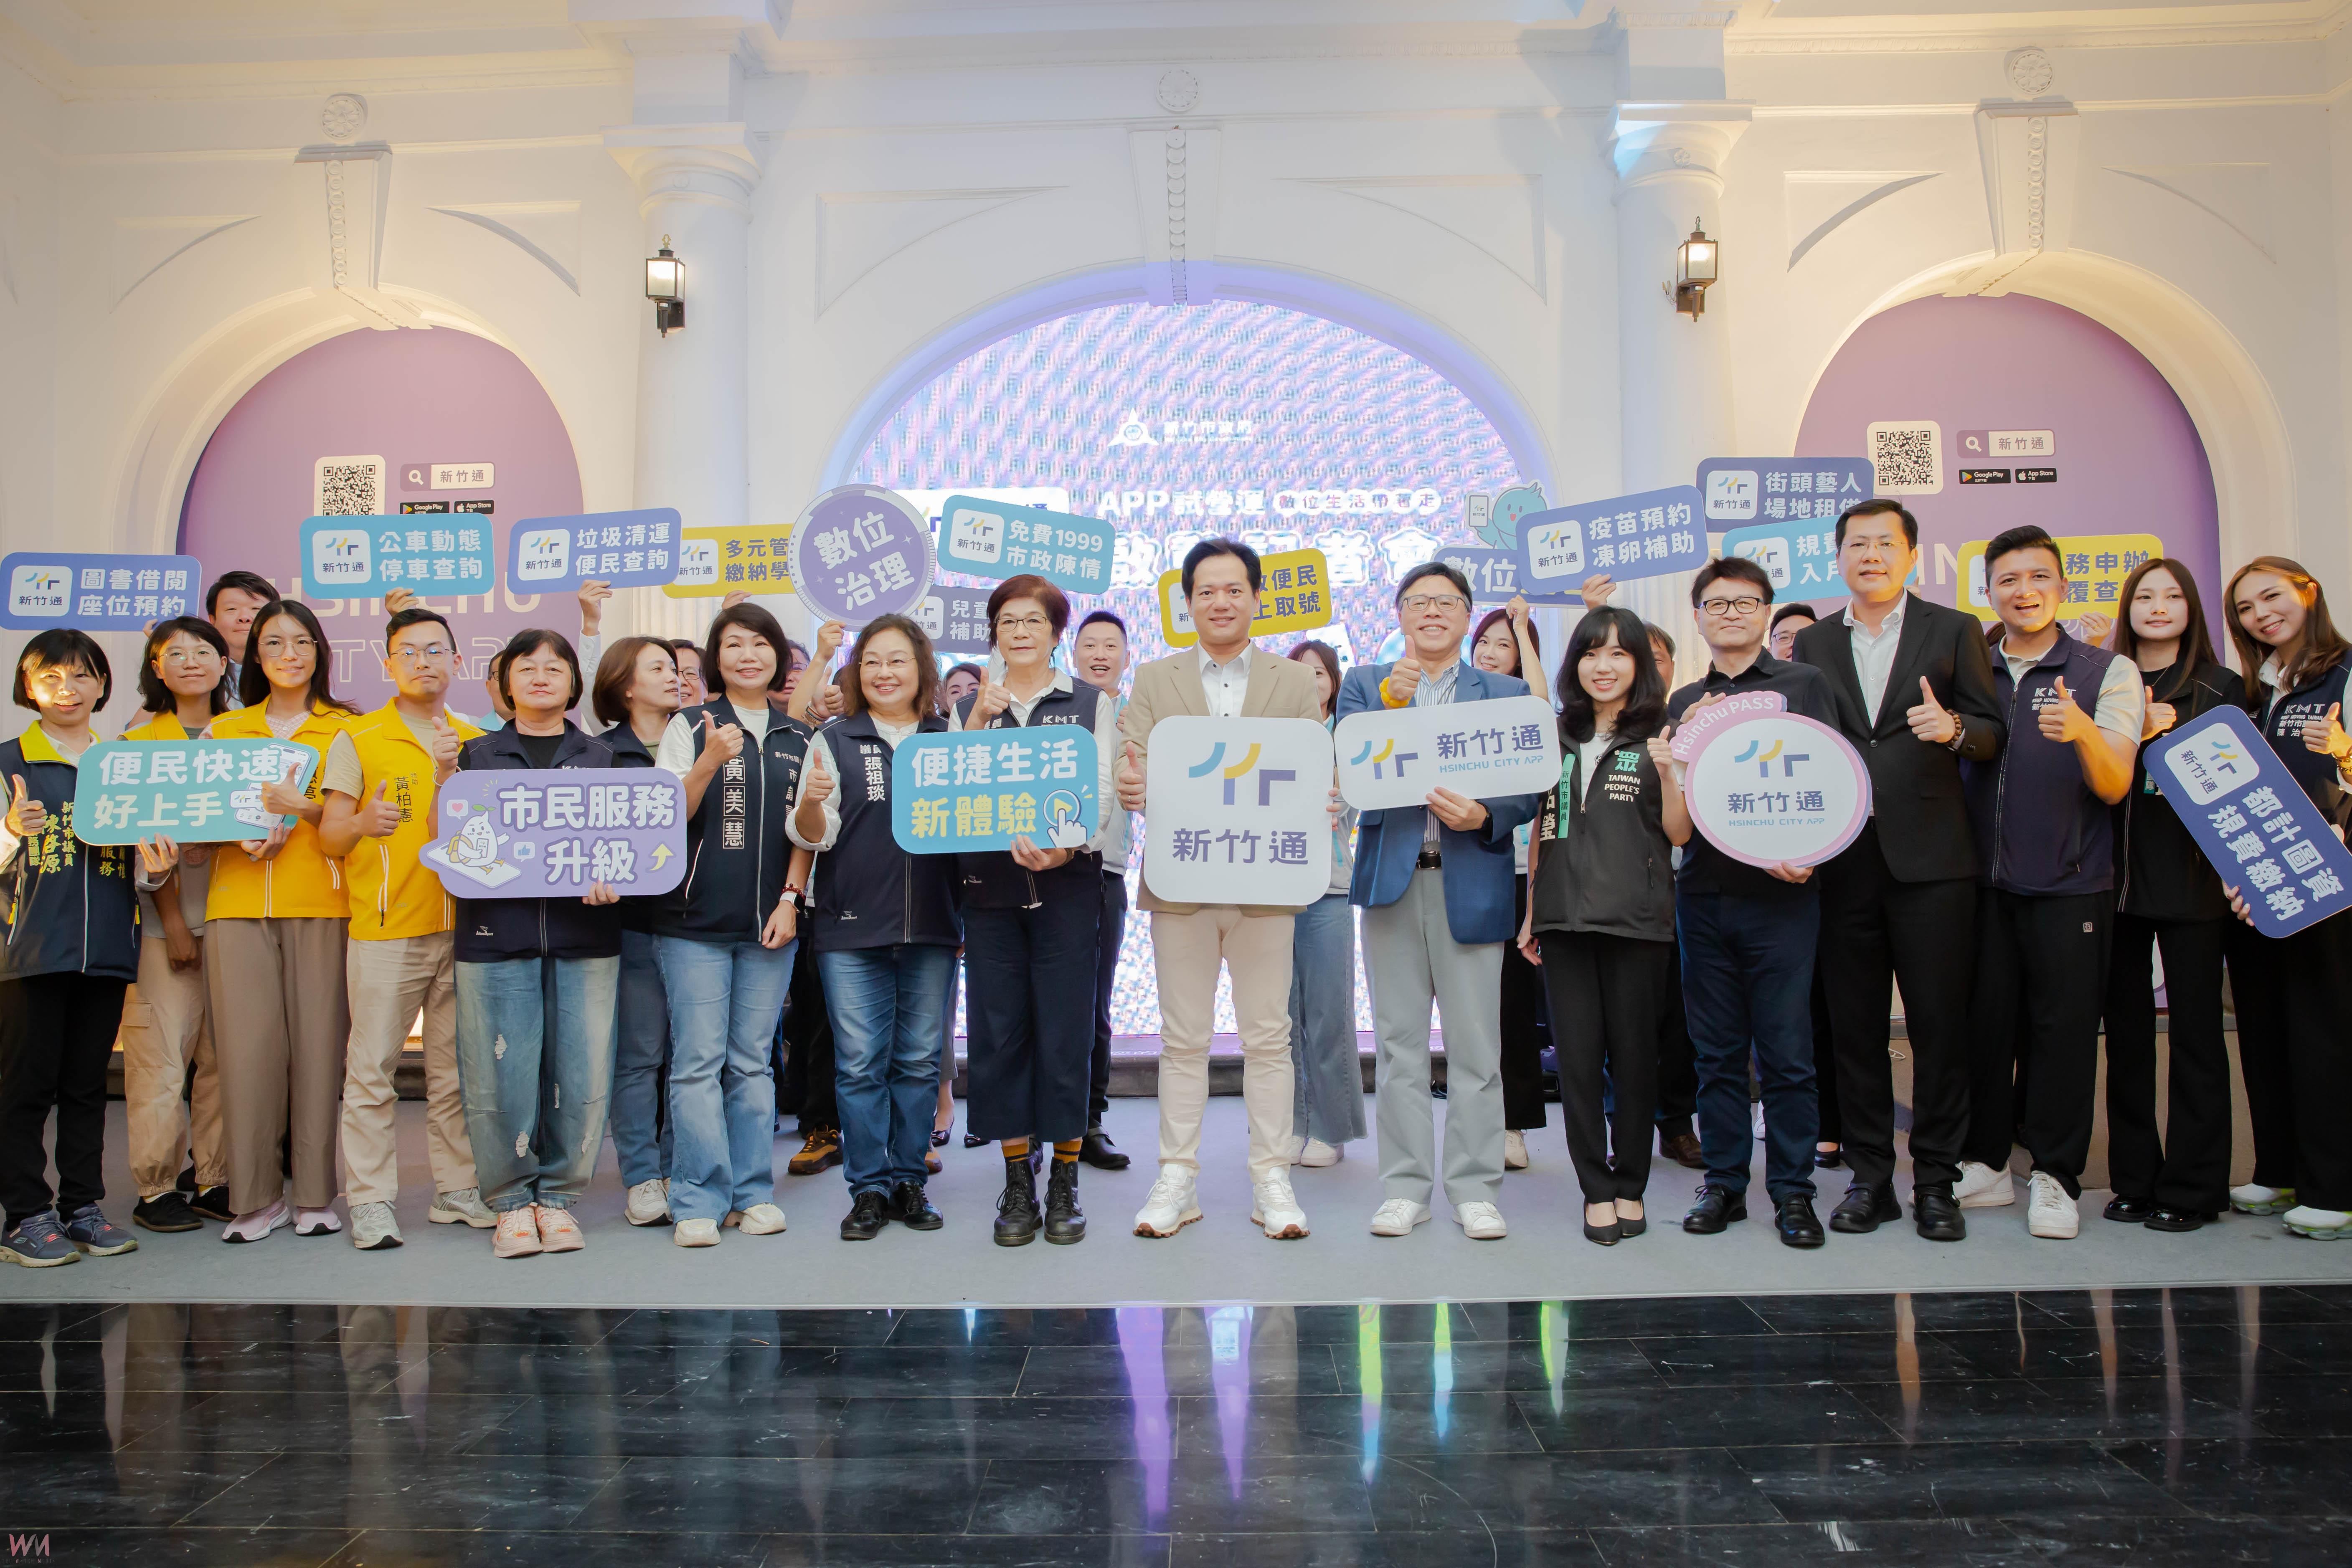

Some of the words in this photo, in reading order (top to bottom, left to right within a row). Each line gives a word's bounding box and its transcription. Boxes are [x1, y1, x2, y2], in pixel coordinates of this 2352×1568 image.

[1999, 437, 2044, 450] 新竹通
[440, 469, 484, 483] 新竹通
[1766, 472, 1862, 493] 街頭藝人
[1713, 499, 1751, 509] 新竹通
[1588, 503, 1692, 540] 疫苗預約
[378, 529, 481, 553] 公車動態
[577, 522, 670, 549] 垃圾清運
[726, 538, 788, 558] 多元管
[814, 511, 895, 571] 數位
[957, 538, 995, 553] 新竹通
[1008, 519, 1103, 553] 免費1999
[1797, 532, 1836, 557] 規費
[1538, 552, 1578, 568] 新竹通
[1592, 531, 1695, 568] 凍卵補助
[322, 562, 365, 573] 新竹通
[380, 557, 482, 581] 停車查詢
[525, 558, 562, 570] 新竹通
[575, 549, 669, 577] 便民查詢
[679, 566, 713, 575] 新竹通
[725, 561, 789, 582] 繳納學
[1007, 546, 1101, 580] 市政陳情
[1443, 556, 1517, 593] 數位
[2065, 550, 2149, 575] 務申辦
[80, 568, 188, 591] 圖書借閱
[835, 551, 915, 611] 治理
[2068, 580, 2119, 603] 覆查
[18, 595, 63, 606] 新竹通
[77, 594, 186, 617] 座位預約
[951, 600, 990, 619] 兒童
[1253, 591, 1321, 621] 上取號
[916, 621, 937, 630] 竹通
[950, 621, 991, 642] 補助
[2034, 688, 2076, 697] KMT
[1043, 715, 1079, 724] KMT
[2284, 704, 2325, 714] KMT
[1675, 707, 1728, 755] Hsinchu
[1728, 697, 1774, 714] PASS
[860, 744, 882, 754] 議員
[1437, 723, 1544, 759] 新竹通
[99, 748, 279, 786] 便民快速
[911, 738, 1078, 787] 便捷生活
[1439, 760, 1490, 774] HSINCHU
[1494, 757, 1522, 768] CITY
[1524, 755, 1544, 766] APP
[2179, 749, 2218, 795] 新竹通
[864, 756, 885, 802] 張祖琰
[1609, 774, 1641, 785] TAIWAN
[394, 776, 413, 822] 黃柏憲
[499, 785, 676, 831] 市民服務
[724, 757, 745, 847] 黃美慧
[1560, 770, 1570, 821] 新竹市議員
[1609, 793, 1634, 802] PARTY
[1728, 791, 1825, 814] 新竹通
[94, 791, 224, 829] 好上手
[911, 793, 1037, 838] 新體驗
[1729, 818, 1775, 827] HSINCHU
[61, 801, 77, 867] 新竹市議員
[1172, 827, 1308, 865] 新竹通
[2241, 786, 2344, 902] 都計圖資
[28, 834, 40, 866] 務團隊
[545, 840, 635, 883] 升級
[2207, 804, 2305, 921] 規費繳納
